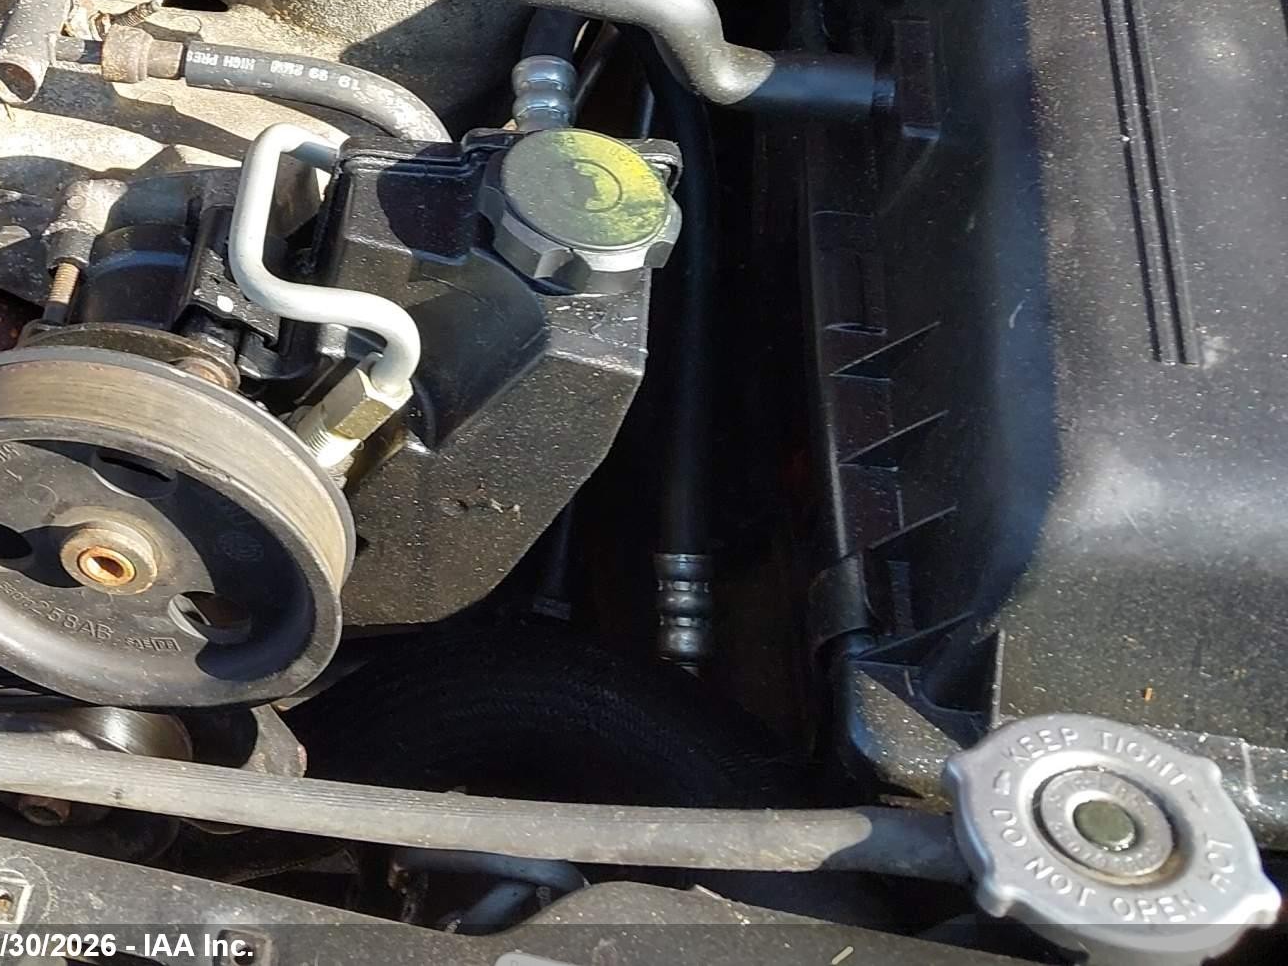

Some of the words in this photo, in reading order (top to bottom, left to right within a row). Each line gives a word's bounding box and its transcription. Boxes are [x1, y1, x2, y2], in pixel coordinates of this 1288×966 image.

[223, 56, 256, 71] HIGH
[999, 727, 1079, 765] KEEP
[1098, 730, 1192, 786] TIGHT
[991, 809, 1028, 847] DO
[1023, 856, 1096, 907] NOT
[1111, 895, 1208, 923] OPEN
[1203, 837, 1235, 894] HOT
